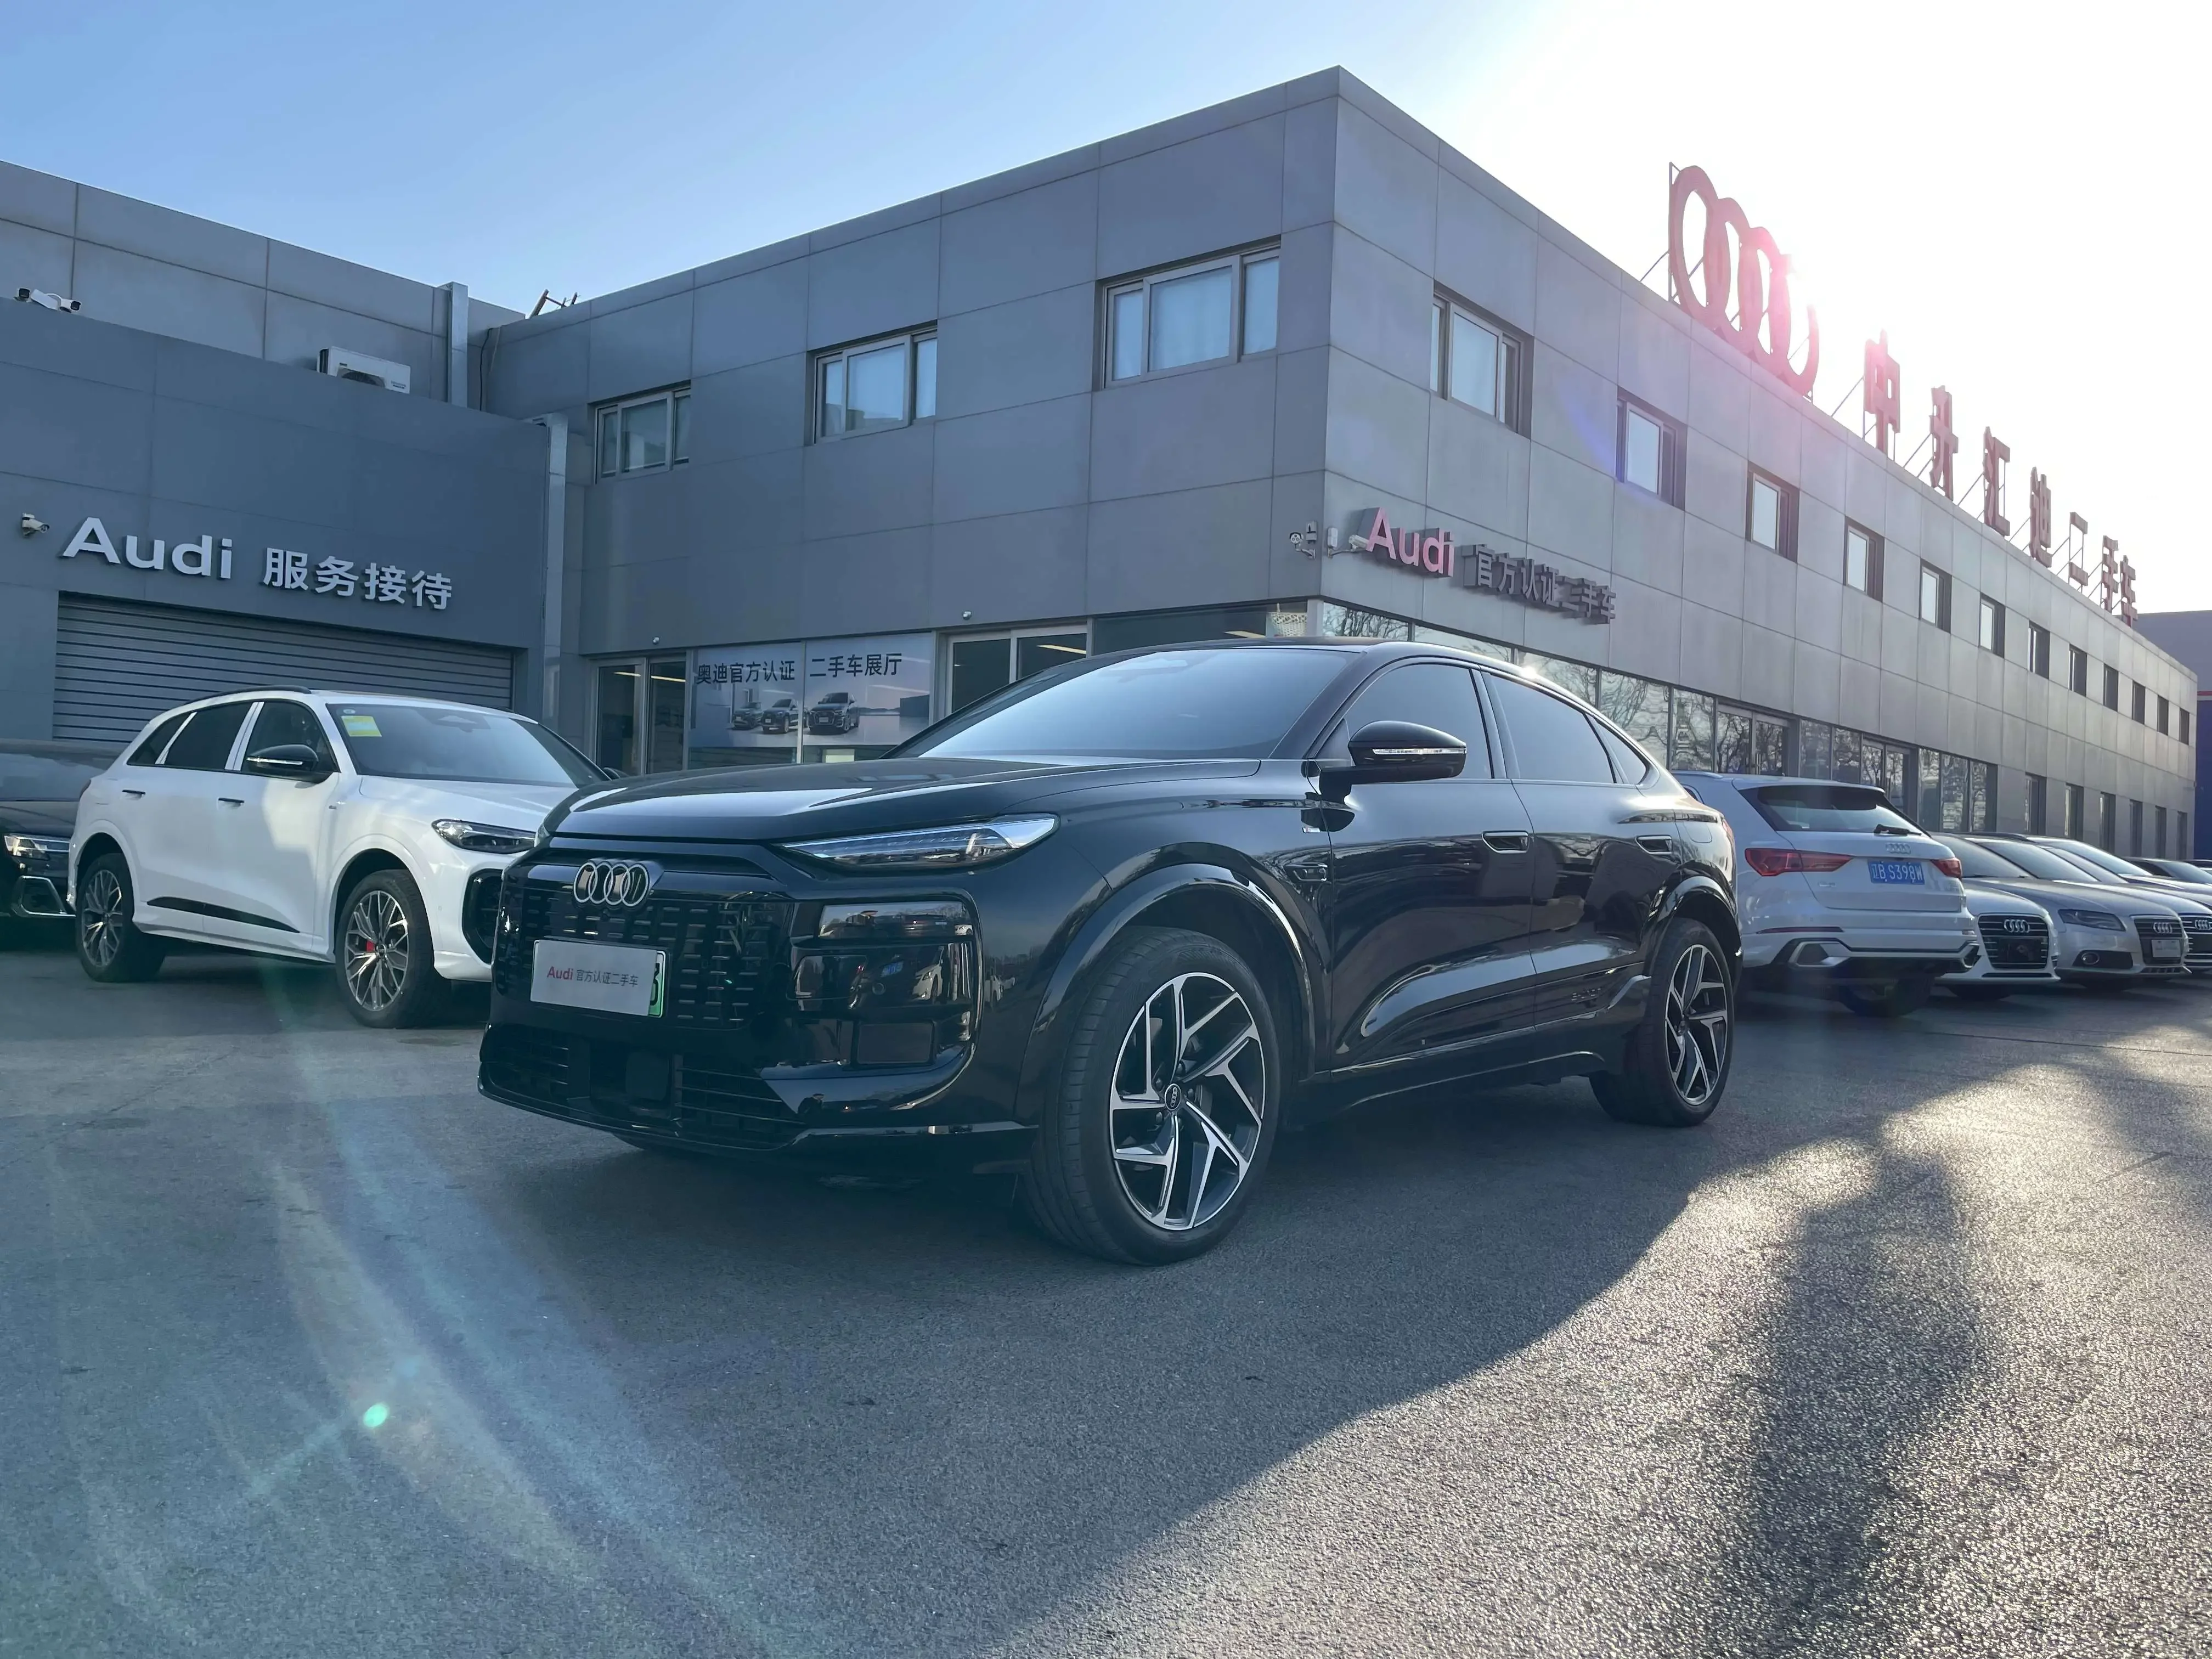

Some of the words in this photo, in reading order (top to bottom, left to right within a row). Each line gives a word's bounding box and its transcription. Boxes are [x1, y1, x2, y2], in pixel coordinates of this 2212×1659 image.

[63, 516, 233, 579] Audi
[263, 547, 453, 610] 服务接待
[1365, 507, 1454, 578] Audi
[1475, 544, 1617, 624] 官方认证二手车
[696, 659, 796, 685] 奥迪官方认证
[809, 652, 903, 678] 二手车展厅
[546, 966, 574, 980] Audi
[576, 969, 639, 988] 官方认证二手车
